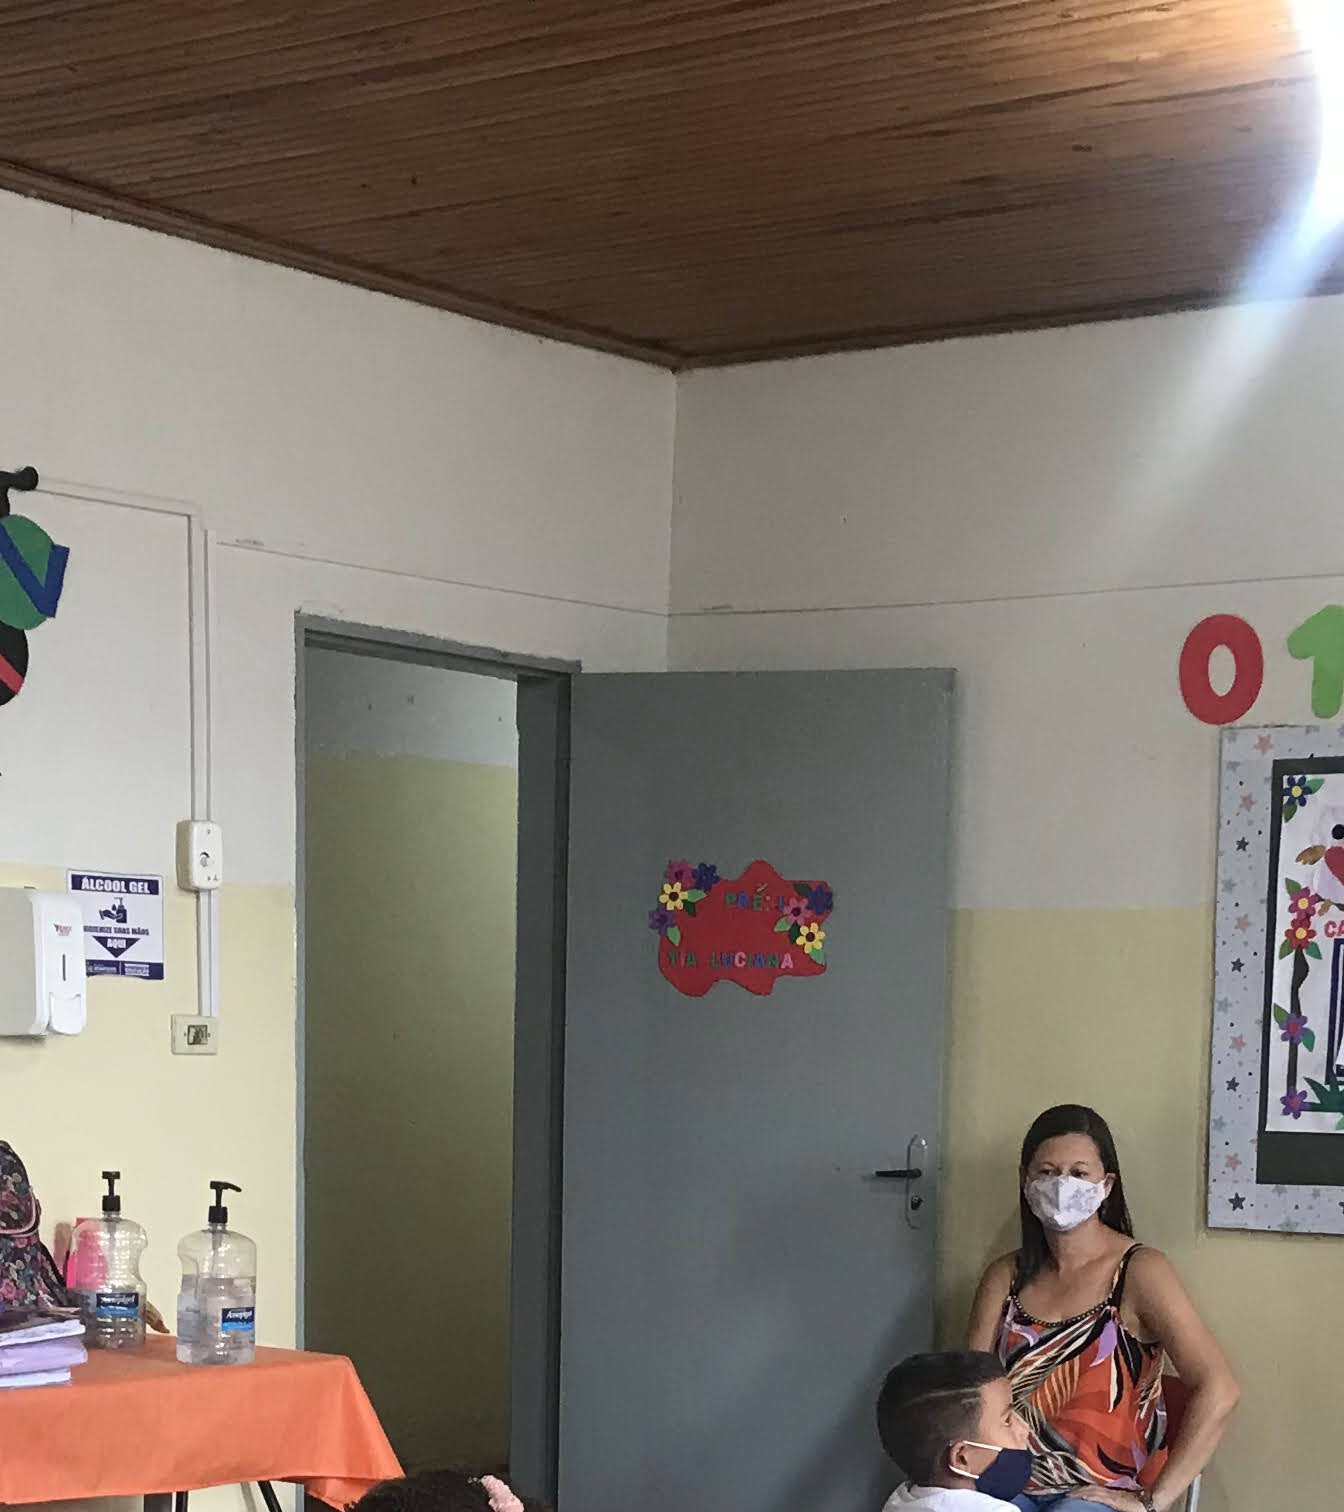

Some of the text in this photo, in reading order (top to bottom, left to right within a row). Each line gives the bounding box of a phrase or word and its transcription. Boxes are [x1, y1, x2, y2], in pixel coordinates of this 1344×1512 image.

[81, 876, 151, 894] ÁLCOOL GEL
[106, 938, 127, 949] AQUI
[710, 951, 794, 969] LUCIANA
